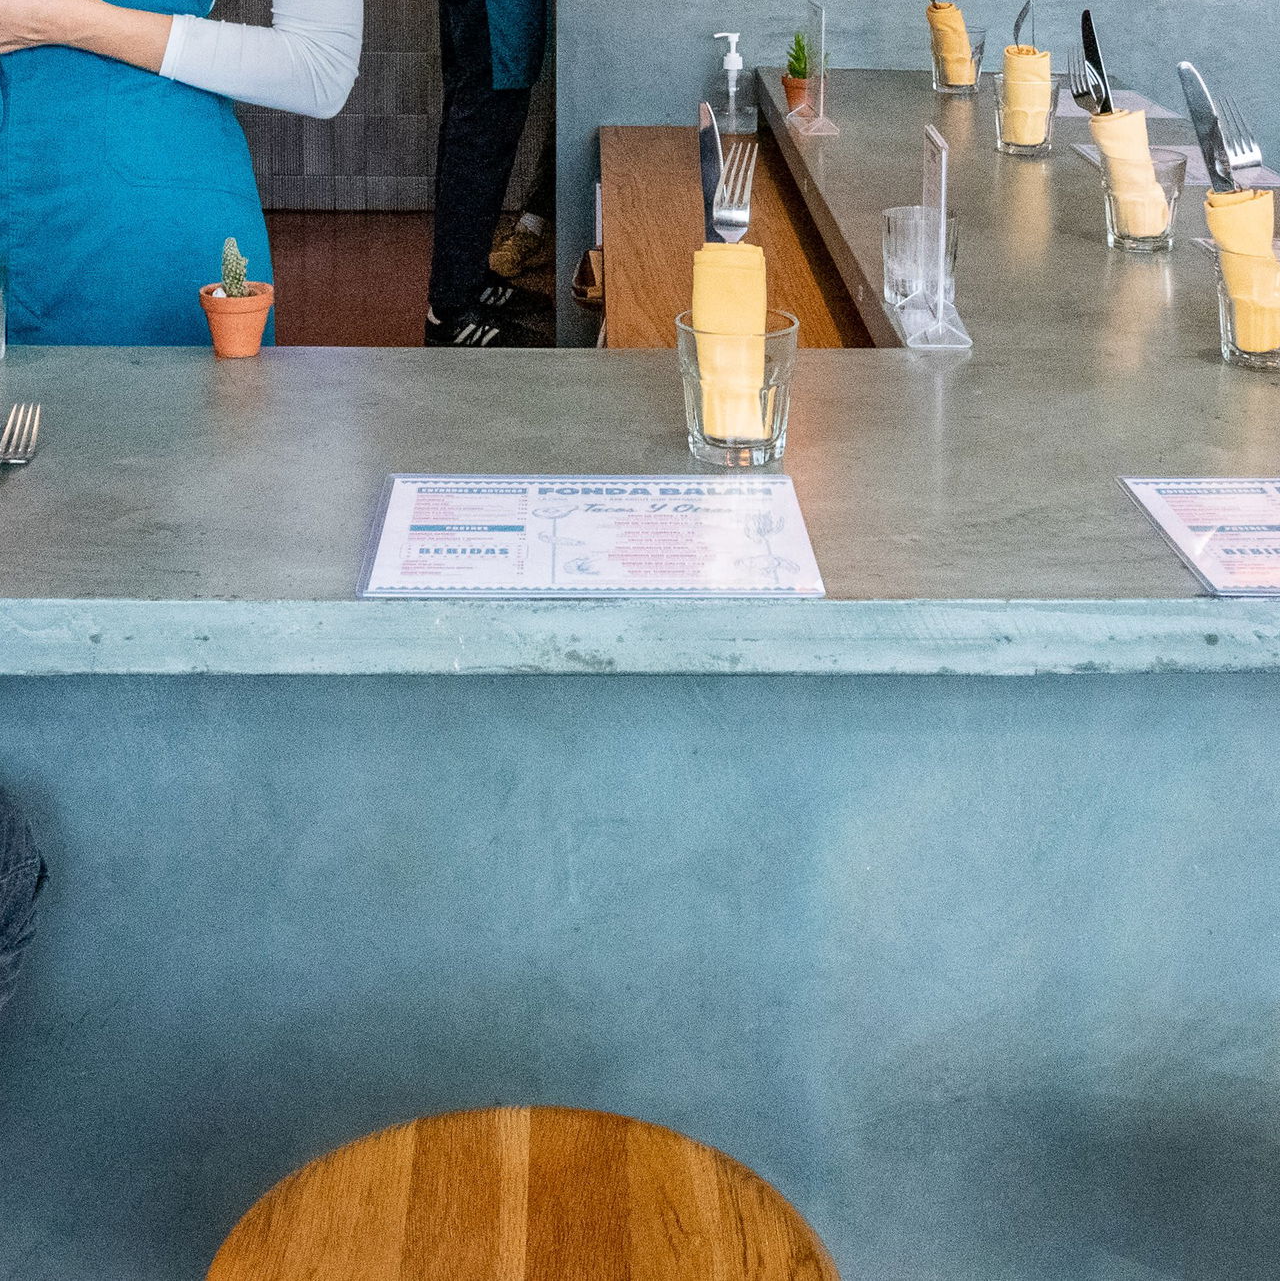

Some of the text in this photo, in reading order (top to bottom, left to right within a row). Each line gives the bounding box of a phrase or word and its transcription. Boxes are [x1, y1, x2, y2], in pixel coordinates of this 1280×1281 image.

[537, 487, 773, 495] FONDA BALAM
[583, 503, 635, 513] Tacos
[419, 547, 509, 555] BEBIDAS
